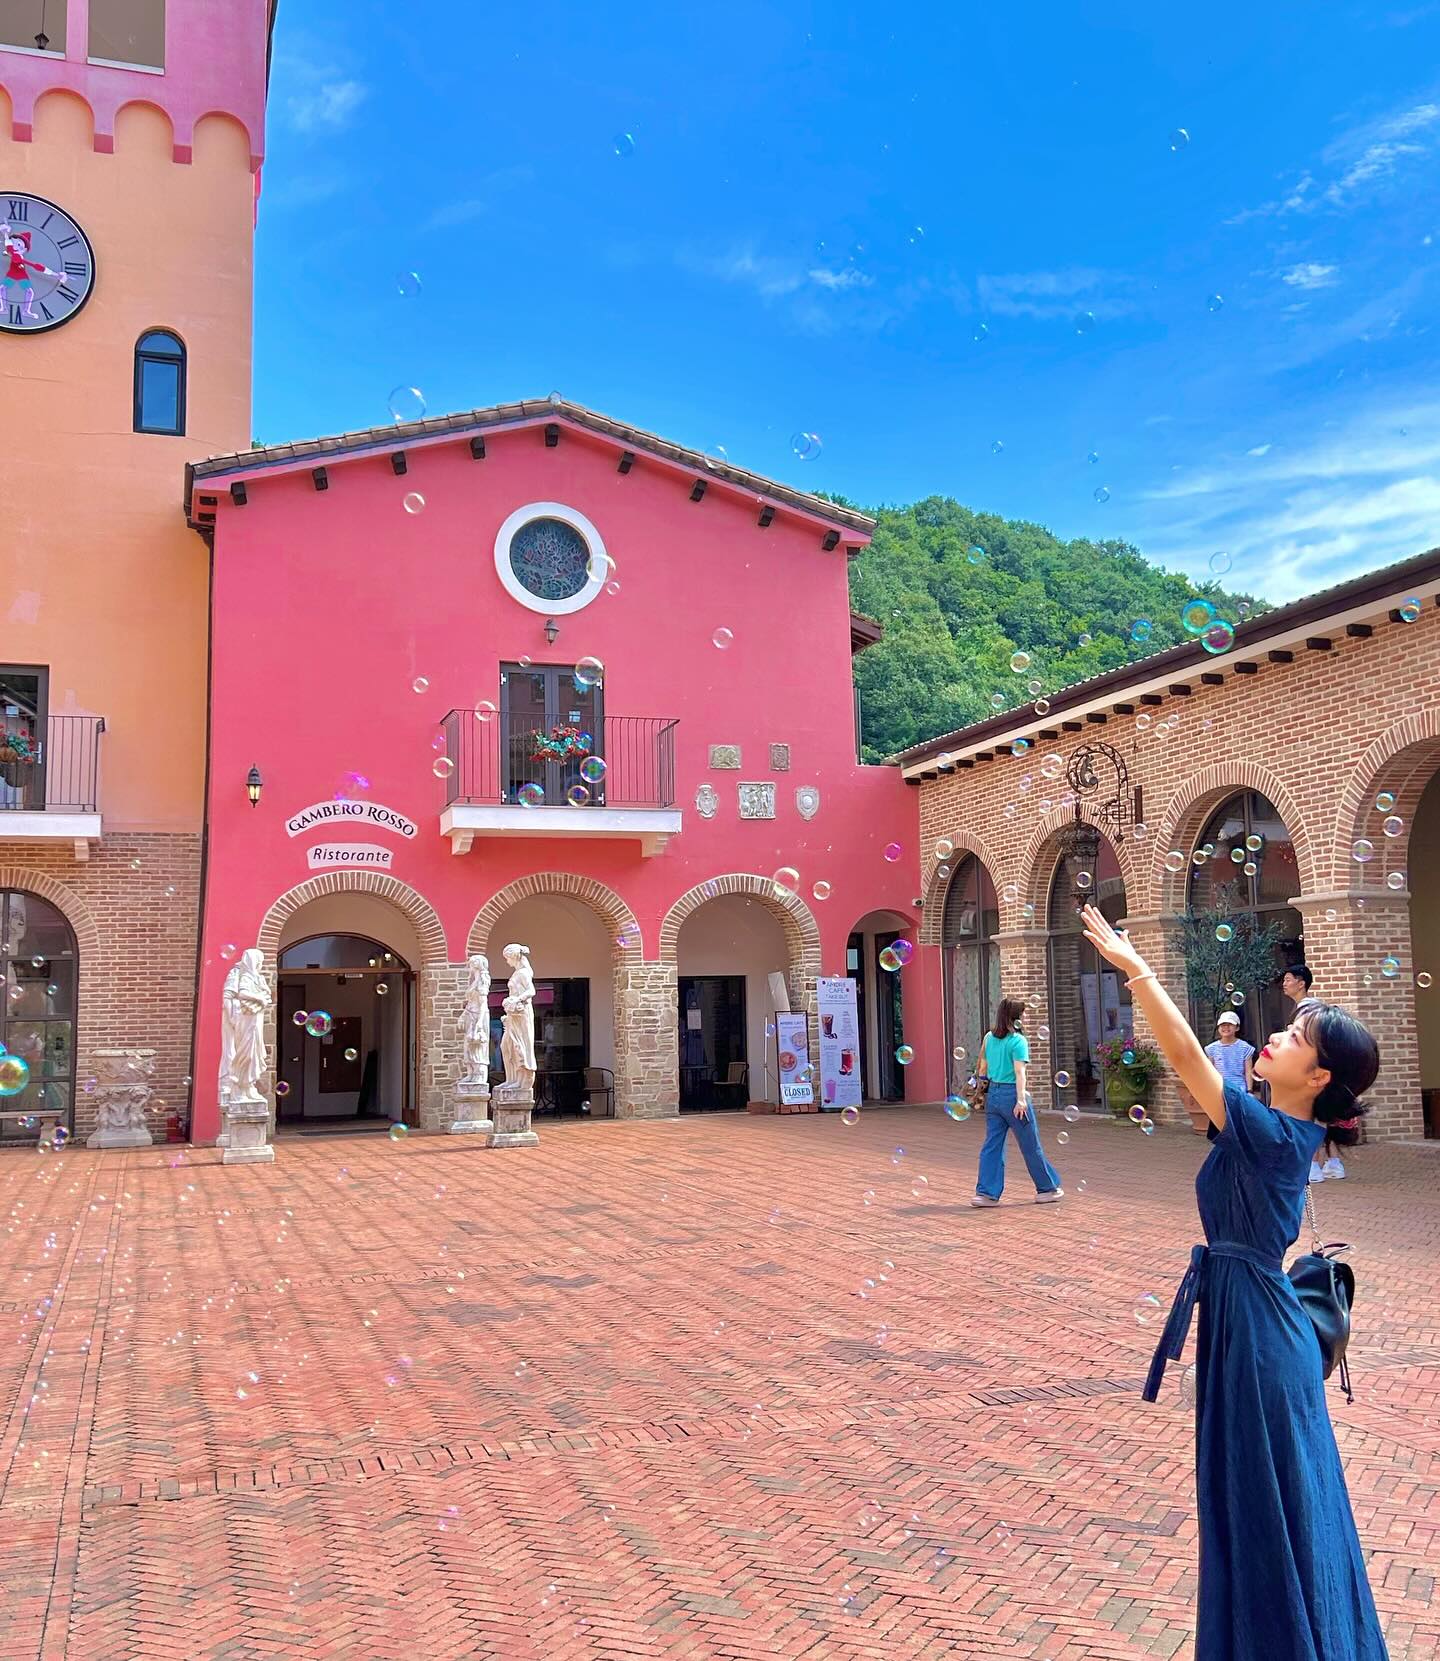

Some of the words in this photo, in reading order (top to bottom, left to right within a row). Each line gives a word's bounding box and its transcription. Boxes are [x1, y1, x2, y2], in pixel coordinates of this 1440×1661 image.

[8, 200, 28, 221] XII
[57, 235, 79, 250] II
[64, 261, 86, 276] III
[288, 804, 364, 832] GAMBERO
[367, 806, 415, 836] ROSSO
[313, 848, 390, 862] Ristorante
[784, 1087, 811, 1097] CLOSED
